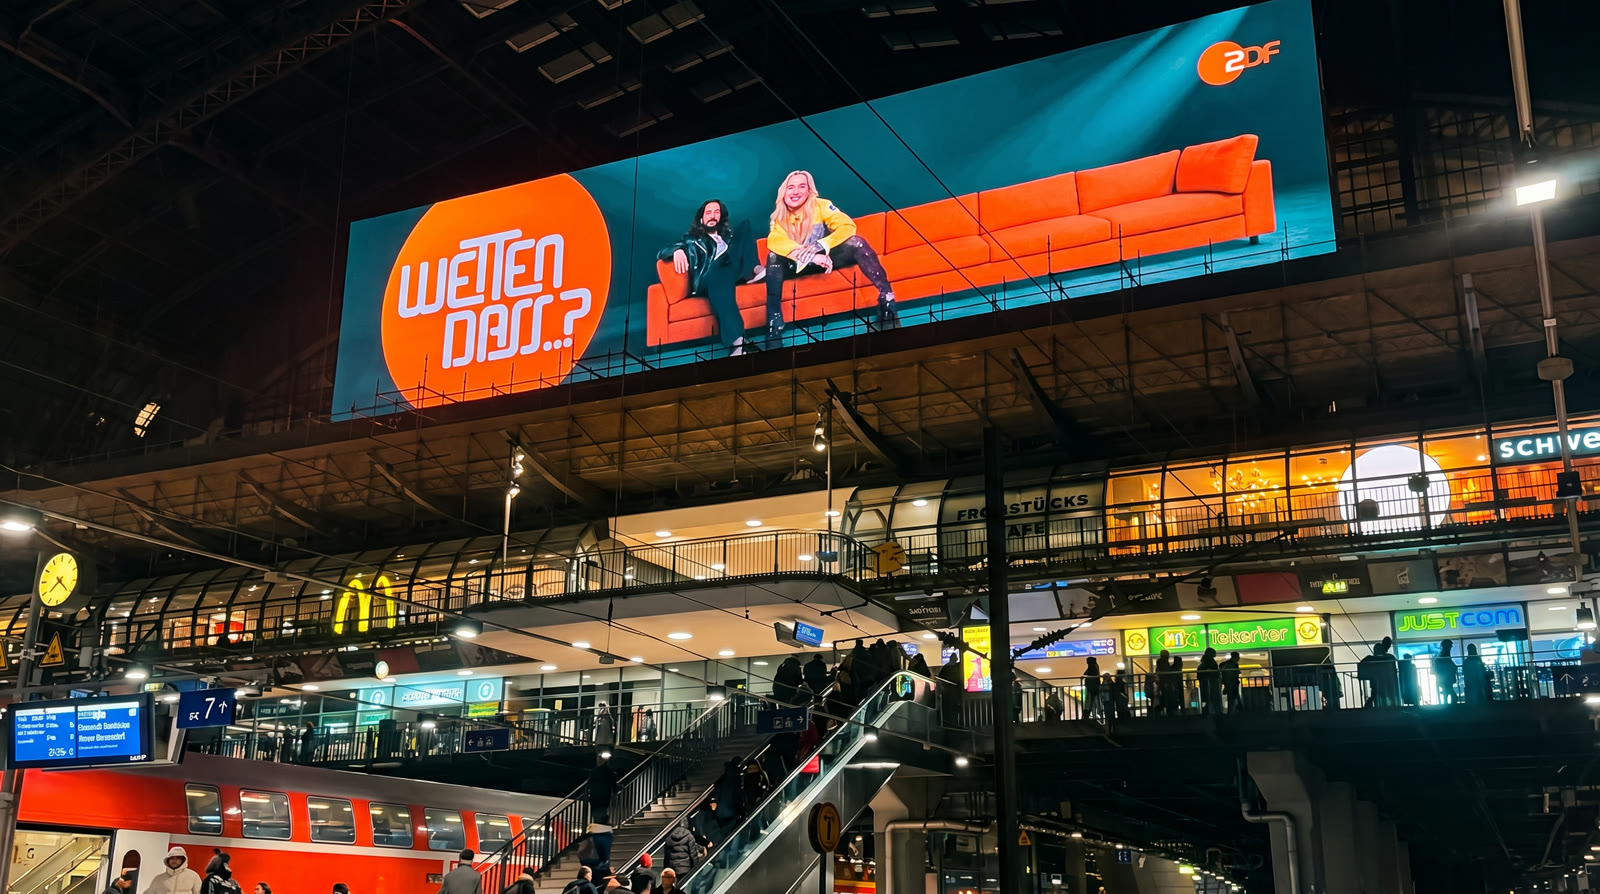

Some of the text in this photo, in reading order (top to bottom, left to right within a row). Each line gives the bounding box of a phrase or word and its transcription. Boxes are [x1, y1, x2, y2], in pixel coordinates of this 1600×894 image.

[397, 228, 565, 319] WETTEN
[957, 494, 1089, 521] FRSTÜCKS
[205, 697, 216, 720] 7
